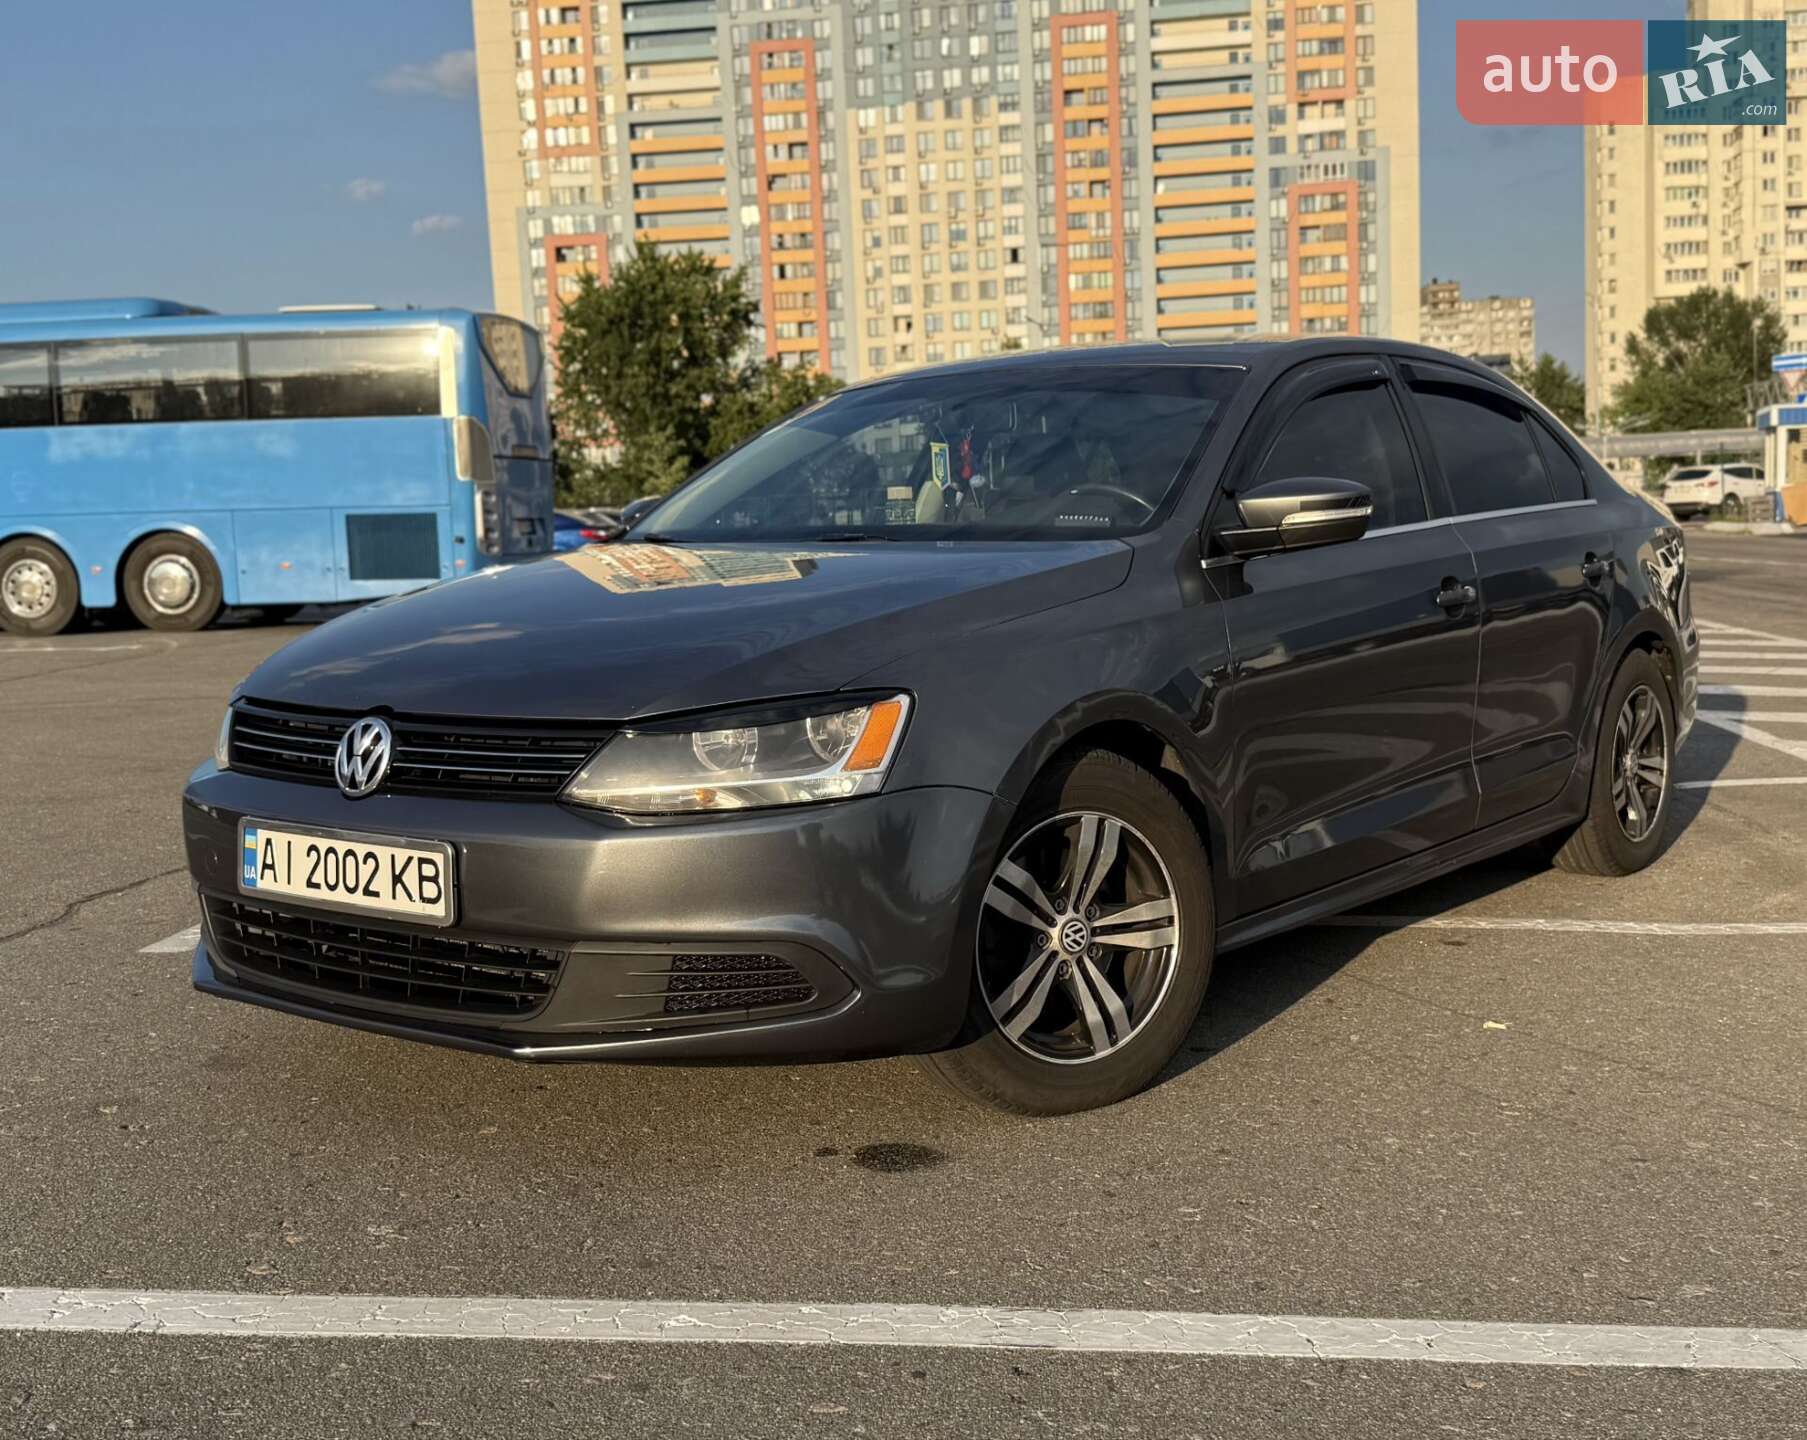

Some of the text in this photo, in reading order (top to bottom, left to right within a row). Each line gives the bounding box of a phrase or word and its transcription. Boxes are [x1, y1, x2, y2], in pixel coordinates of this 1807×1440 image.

[244, 864, 257, 880] UA
[260, 837, 443, 905] AI 2002 KB
